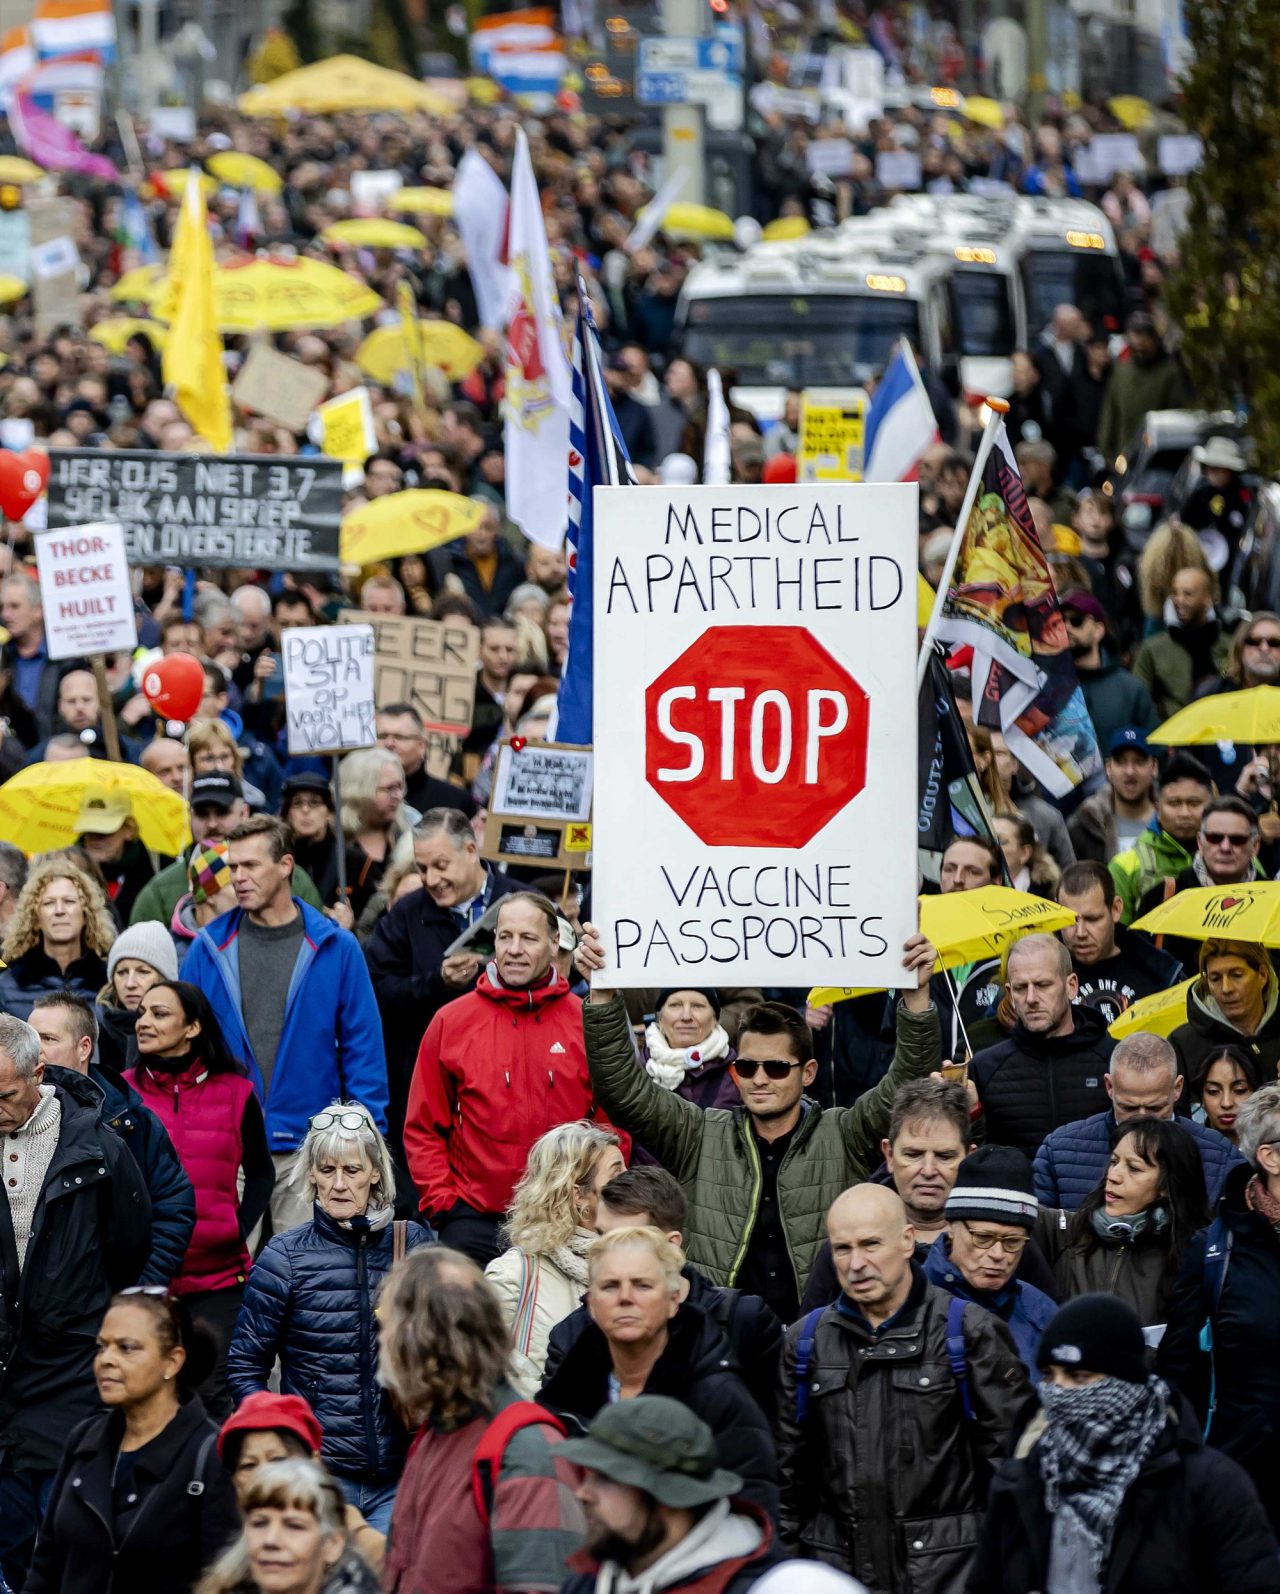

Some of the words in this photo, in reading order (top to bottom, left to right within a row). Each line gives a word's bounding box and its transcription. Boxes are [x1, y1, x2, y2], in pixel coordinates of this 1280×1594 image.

[156, 494, 215, 525] AAN
[665, 502, 860, 545] MEDICAL
[48, 536, 113, 558] THOR-
[54, 563, 114, 587] BECKE
[607, 554, 903, 613] APARTHEID
[59, 595, 116, 618] HUILT
[287, 635, 375, 673] POLITIE
[376, 621, 469, 665] EER
[304, 658, 361, 687] STA
[314, 687, 349, 710] OP
[377, 664, 470, 725] ORG
[291, 706, 334, 728] VOOR
[303, 716, 376, 749] VOLK
[656, 685, 849, 785] STOP
[660, 864, 851, 907] VACCINE
[615, 915, 888, 969] PASSPORTS
